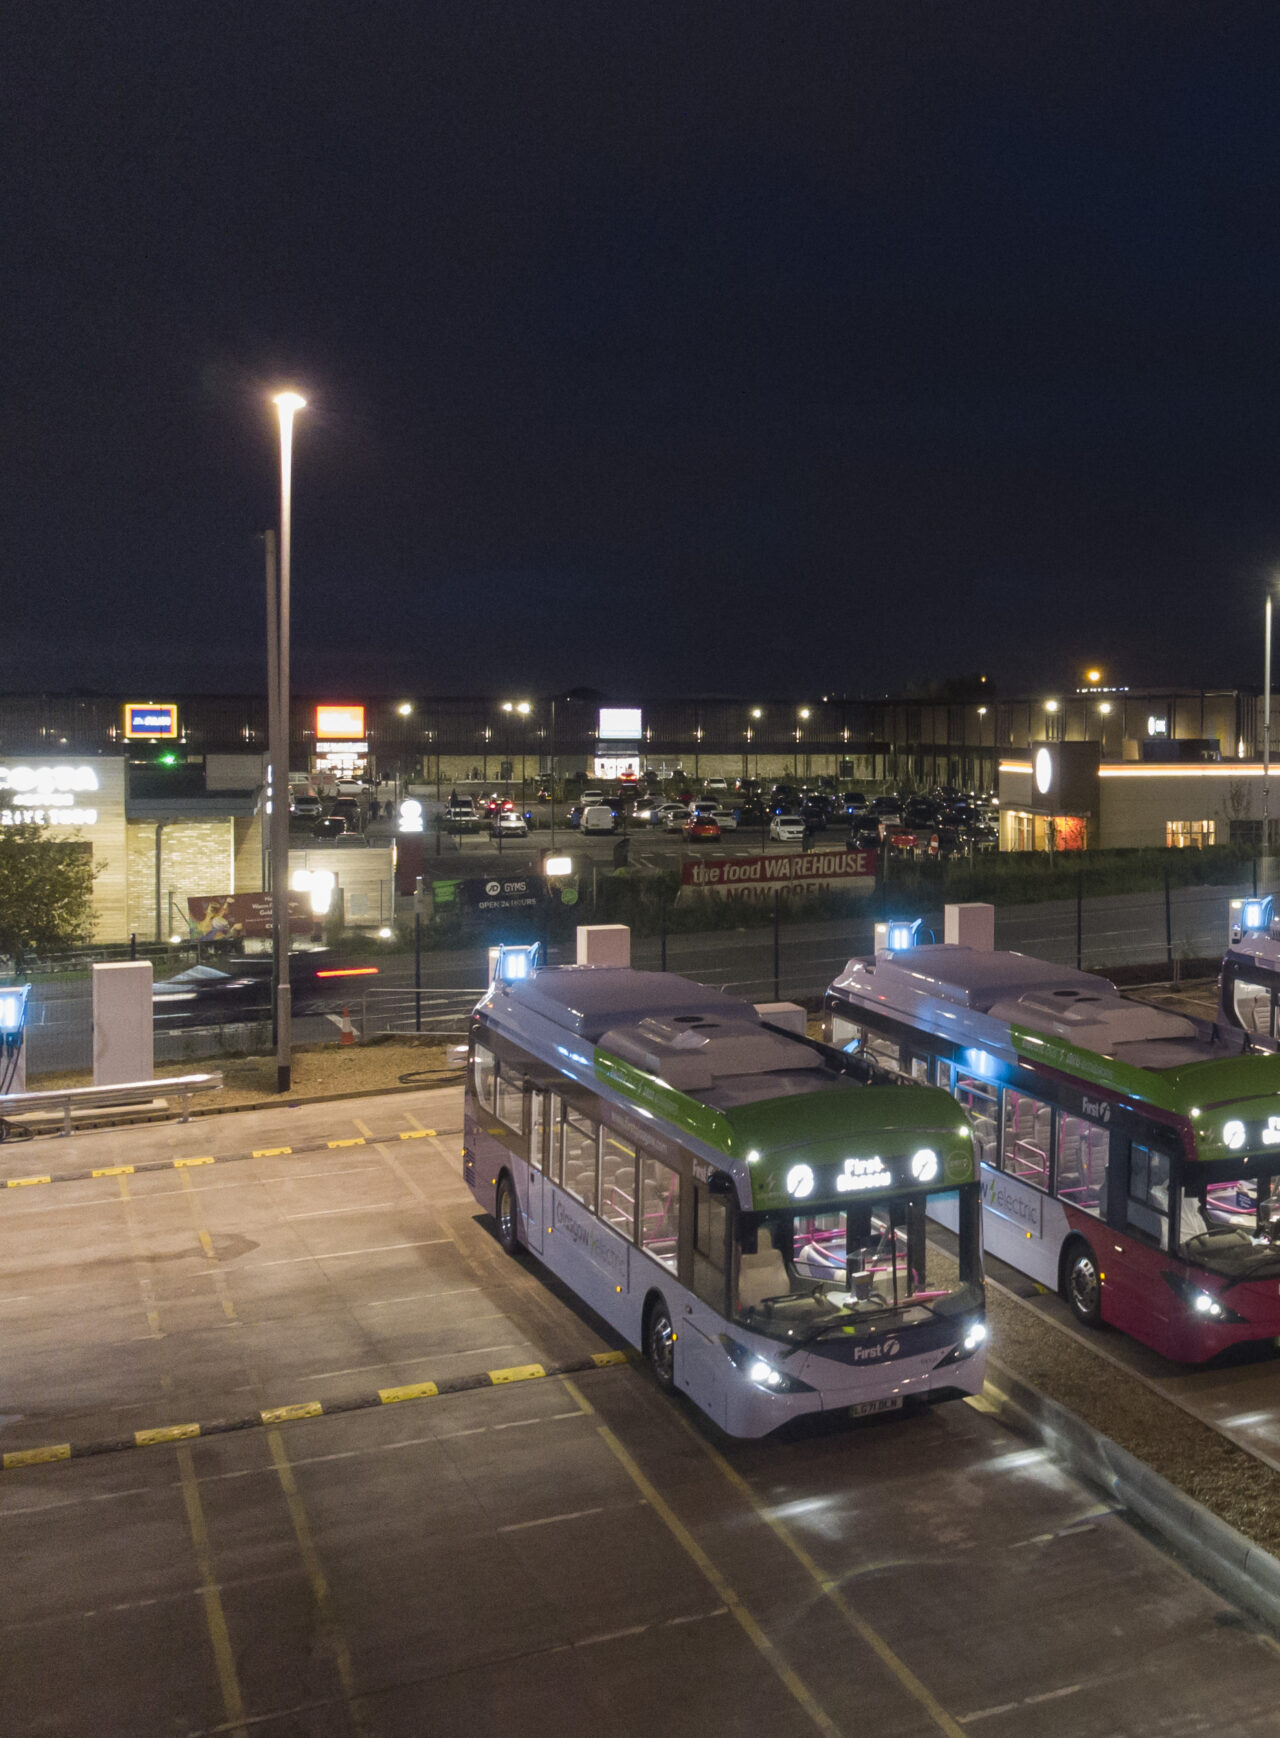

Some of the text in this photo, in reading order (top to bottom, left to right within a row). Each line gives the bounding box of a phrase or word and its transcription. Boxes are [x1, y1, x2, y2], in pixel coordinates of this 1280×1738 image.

[693, 853, 867, 883] the food WAREHOUSE
[504, 882, 526, 893] GYMS
[479, 901, 500, 909] OPEN
[501, 900, 510, 908] 24
[1082, 1096, 1099, 1118] First
[997, 1186, 1037, 1225] electric
[557, 1201, 589, 1246] Glasgow
[854, 1344, 882, 1361] First
